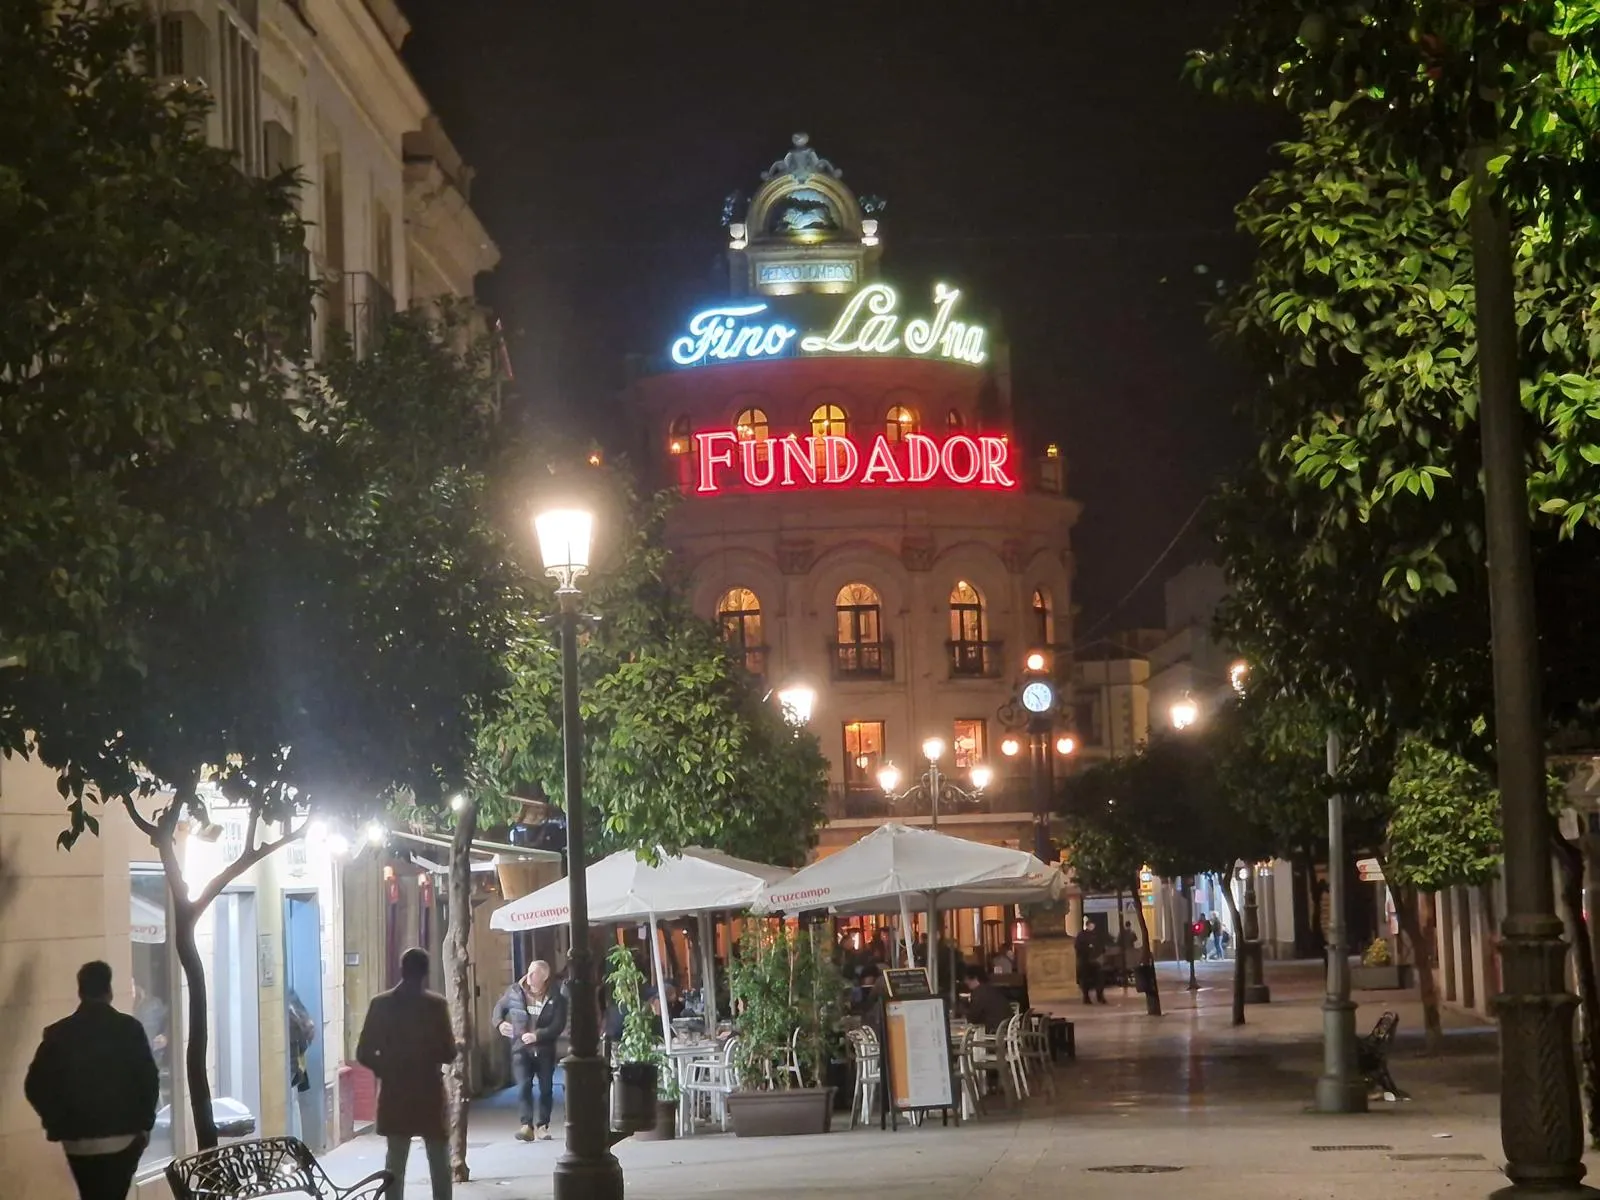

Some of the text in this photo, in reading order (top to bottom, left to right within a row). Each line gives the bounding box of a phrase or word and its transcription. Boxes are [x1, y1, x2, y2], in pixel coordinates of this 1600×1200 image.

[671, 303, 796, 365] Fino
[800, 283, 899, 353] La
[695, 430, 1014, 492] FUNDADOR
[510, 906, 569, 922] Cruzcampo
[770, 887, 831, 904] Cruzcampo
